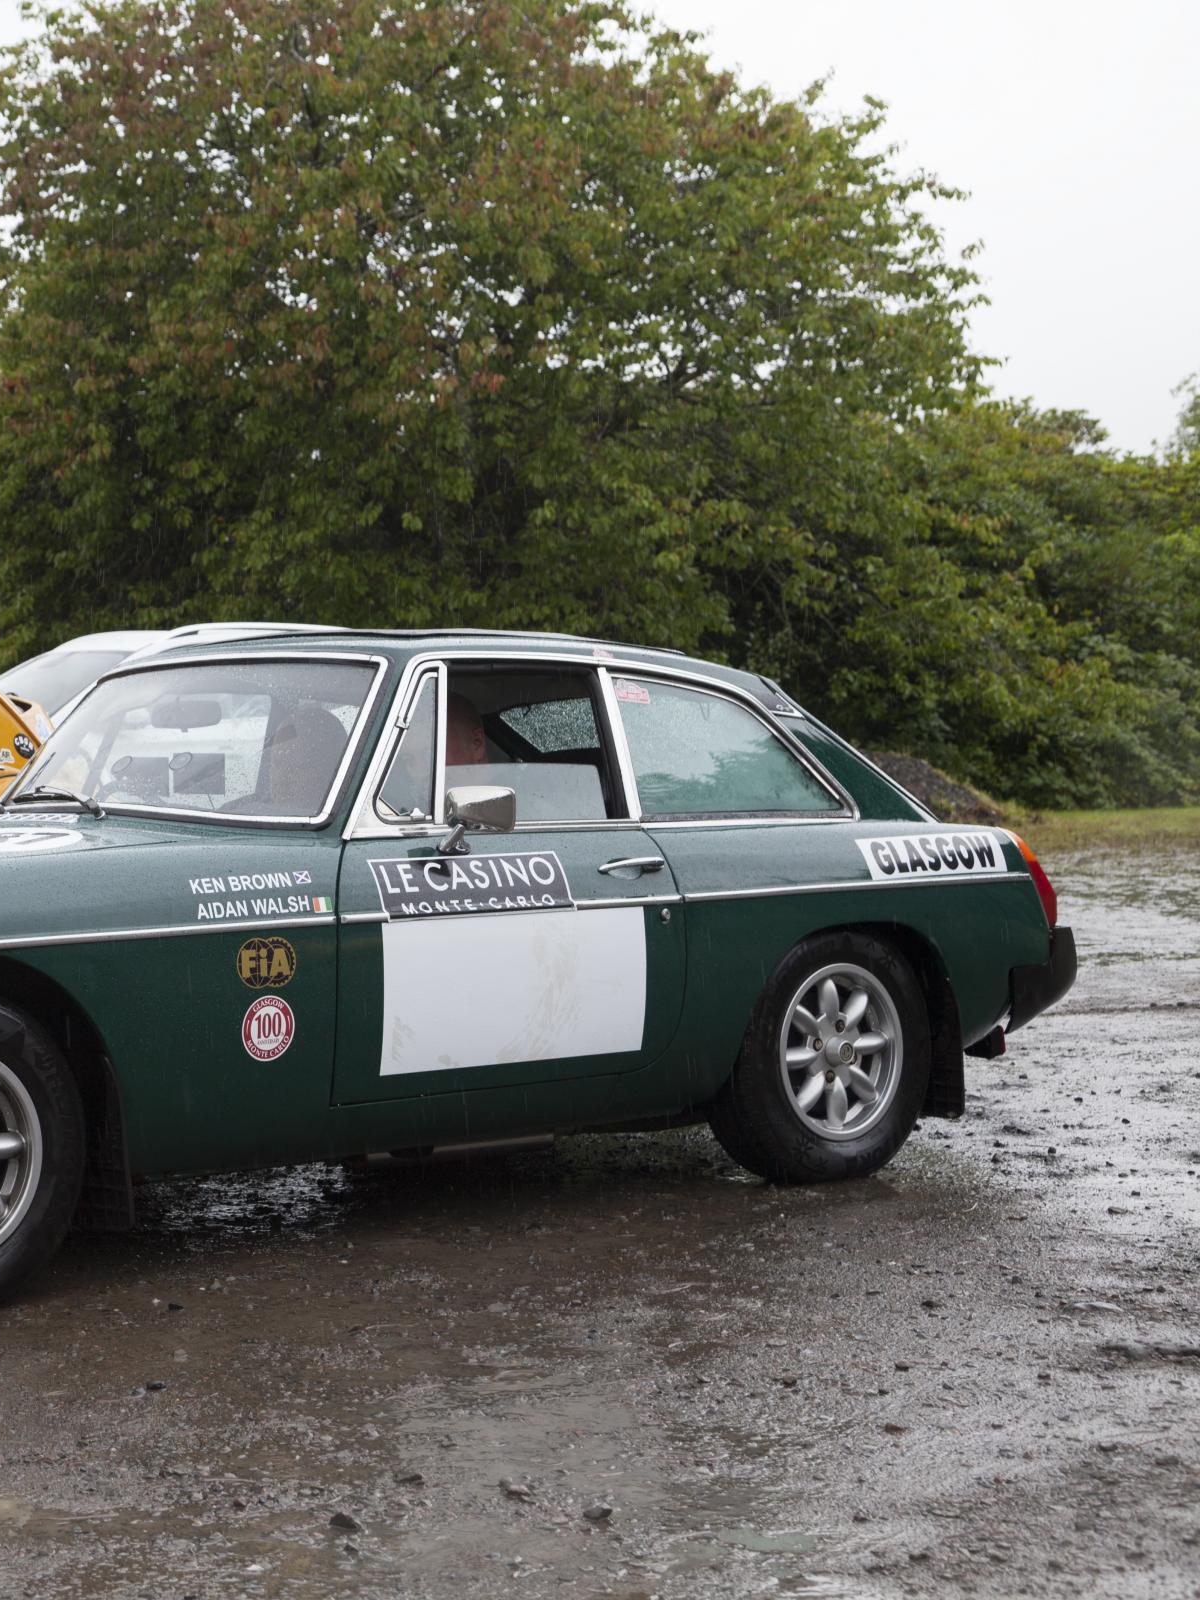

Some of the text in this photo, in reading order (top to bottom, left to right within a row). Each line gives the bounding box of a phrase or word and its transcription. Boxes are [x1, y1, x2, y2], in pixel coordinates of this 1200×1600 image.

[869, 834, 996, 876] GLASGOW
[189, 872, 293, 894] KEN BROWN
[379, 856, 556, 894] LE CASINO
[197, 895, 311, 920] AIDAN WALSH
[401, 893, 556, 915] MONTE CARLO
[252, 998, 285, 1013] GLASGOW
[255, 1012, 282, 1039] 100
[246, 1035, 290, 1059] MONTE CARLO
